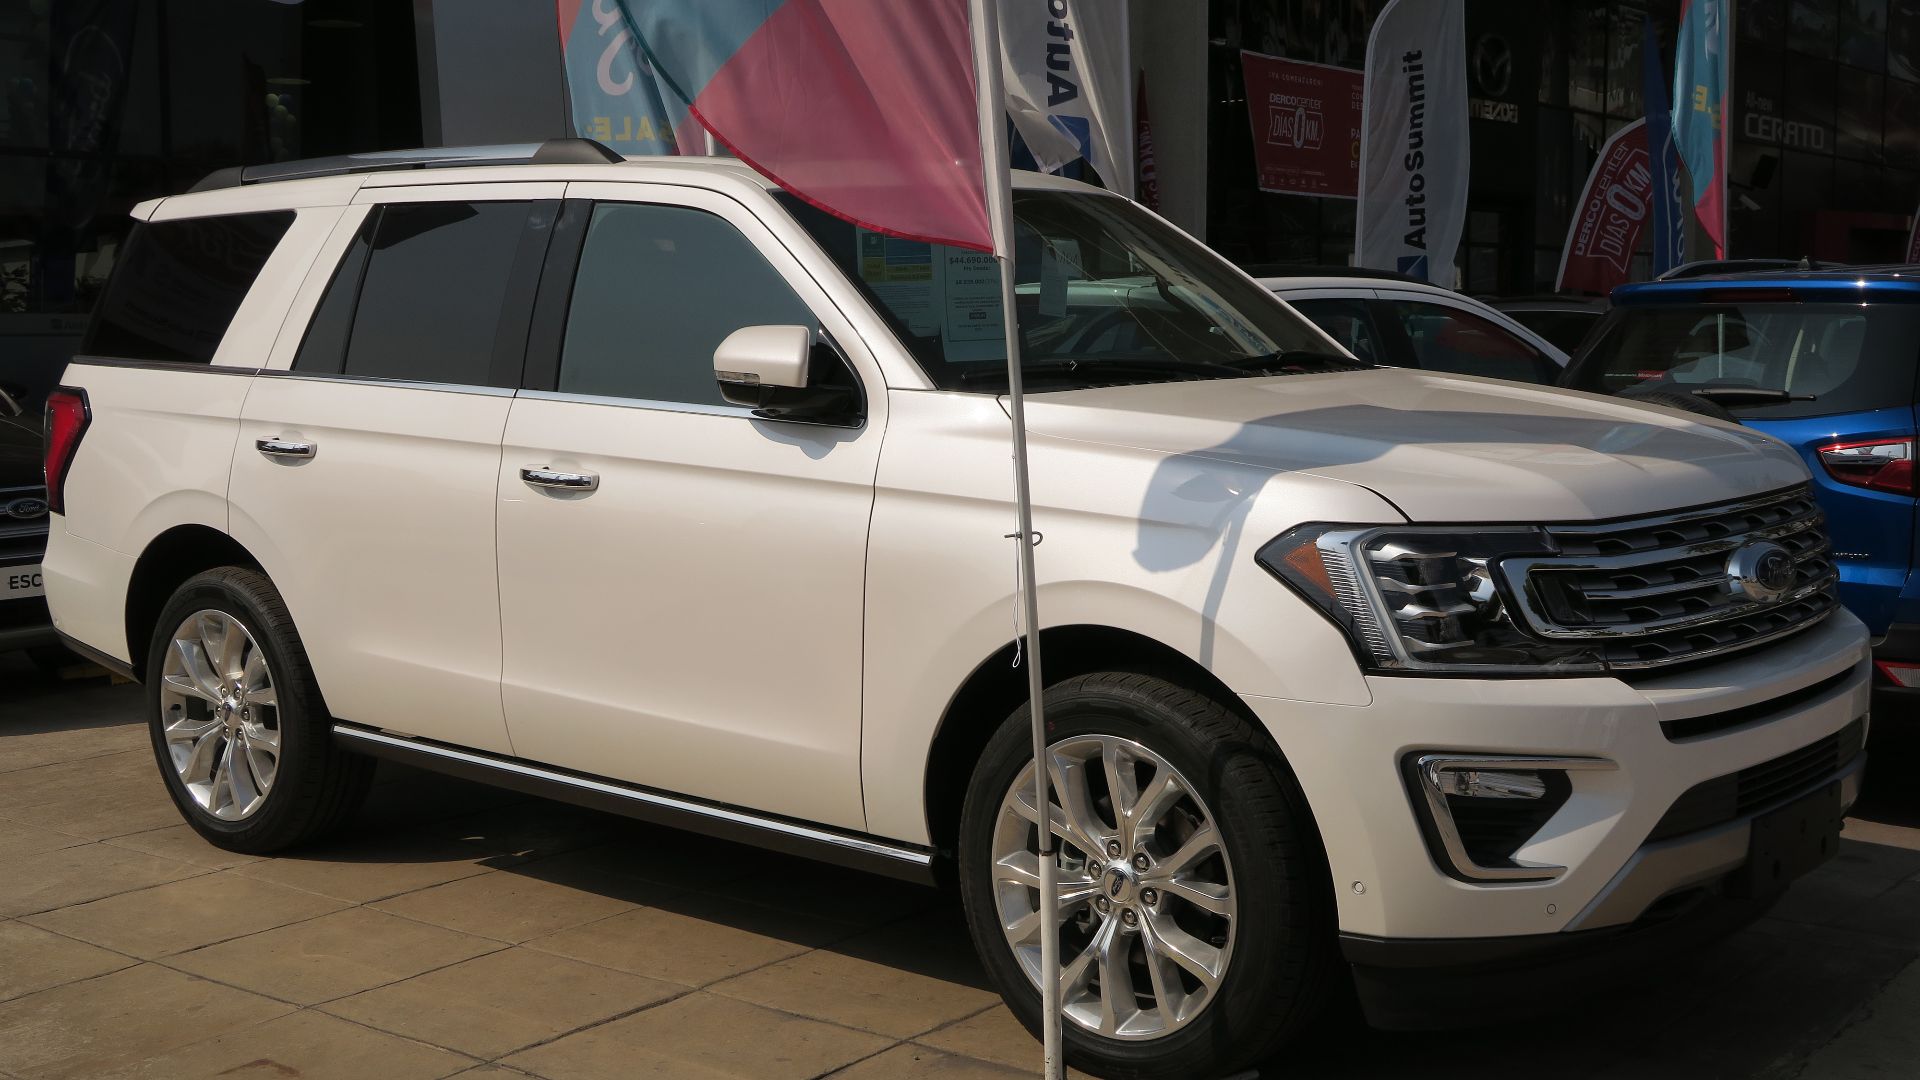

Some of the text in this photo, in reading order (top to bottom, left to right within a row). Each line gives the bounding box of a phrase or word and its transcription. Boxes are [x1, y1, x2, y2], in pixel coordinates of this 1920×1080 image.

[1403, 49, 1426, 250] AutoSummit
[1744, 112, 1825, 149] CERATO
[1575, 142, 1628, 256] DERCOcenter
[1600, 213, 1630, 256] DÍAS
[9, 573, 42, 590] ESC
